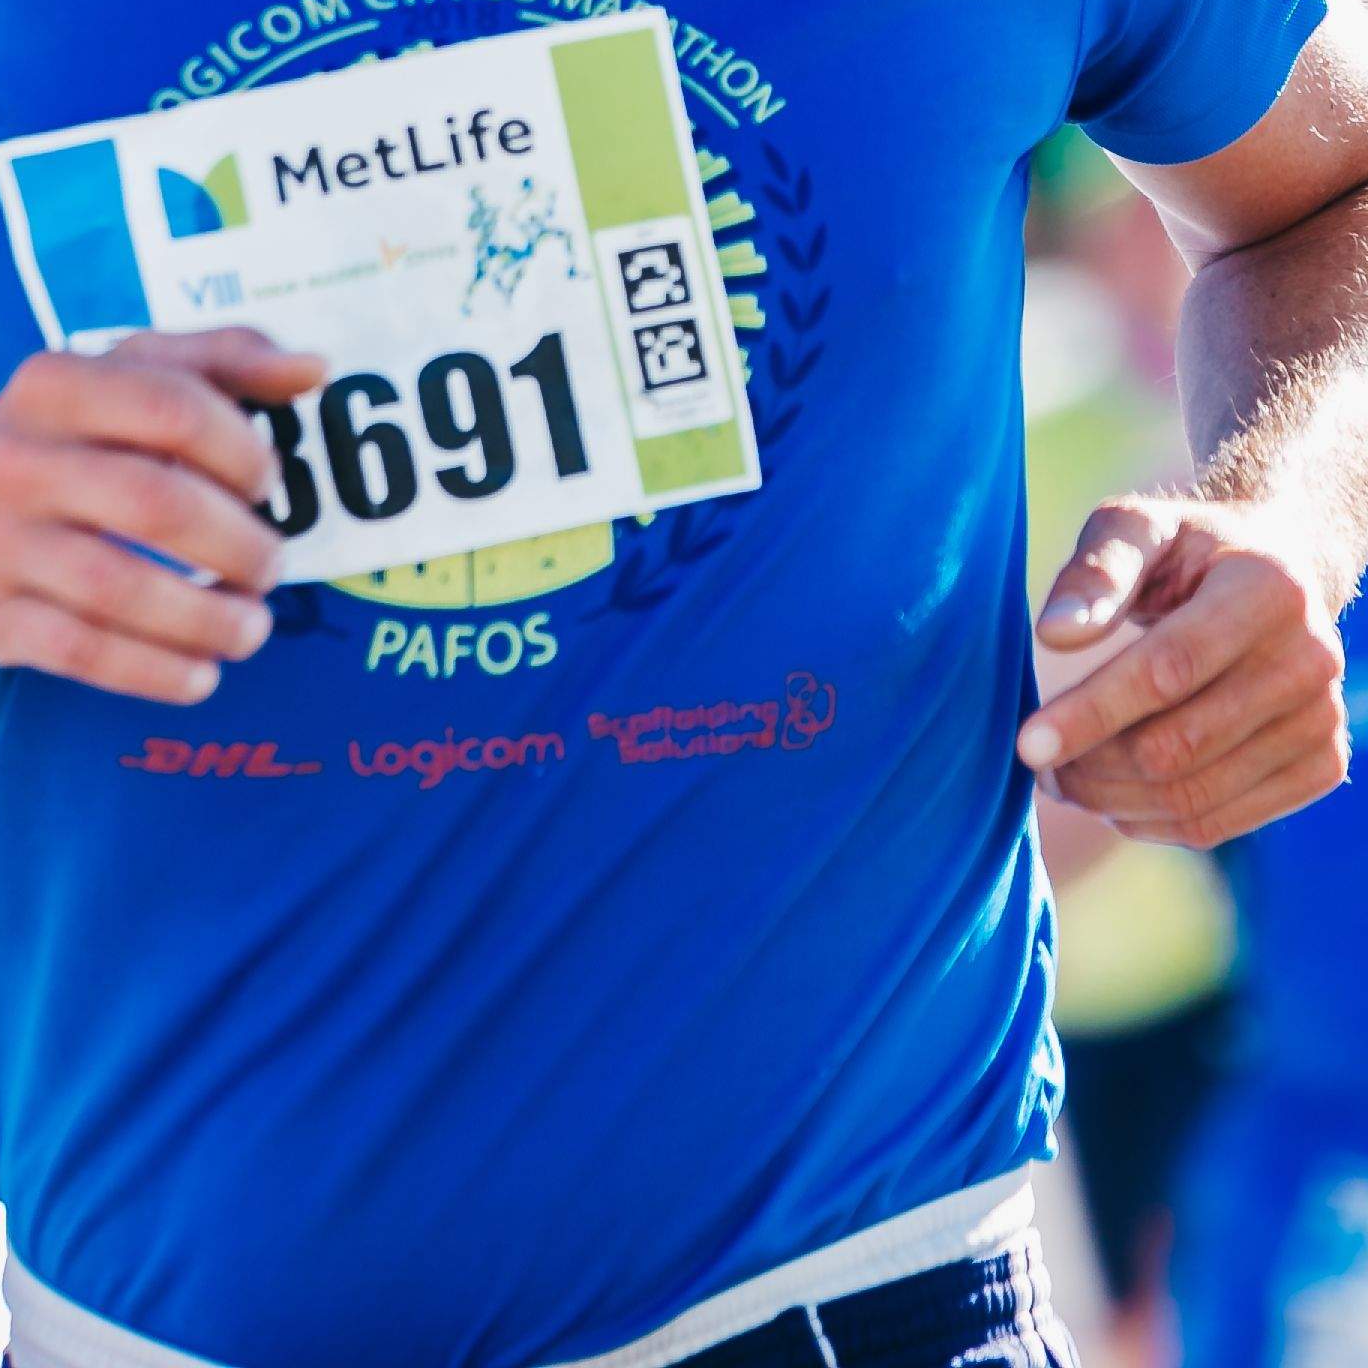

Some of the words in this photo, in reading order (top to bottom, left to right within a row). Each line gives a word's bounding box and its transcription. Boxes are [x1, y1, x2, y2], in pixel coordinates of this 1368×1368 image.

[272, 108, 533, 204] MetLife
[366, 612, 559, 678] PAFOS
[142, 736, 292, 778] DHL
